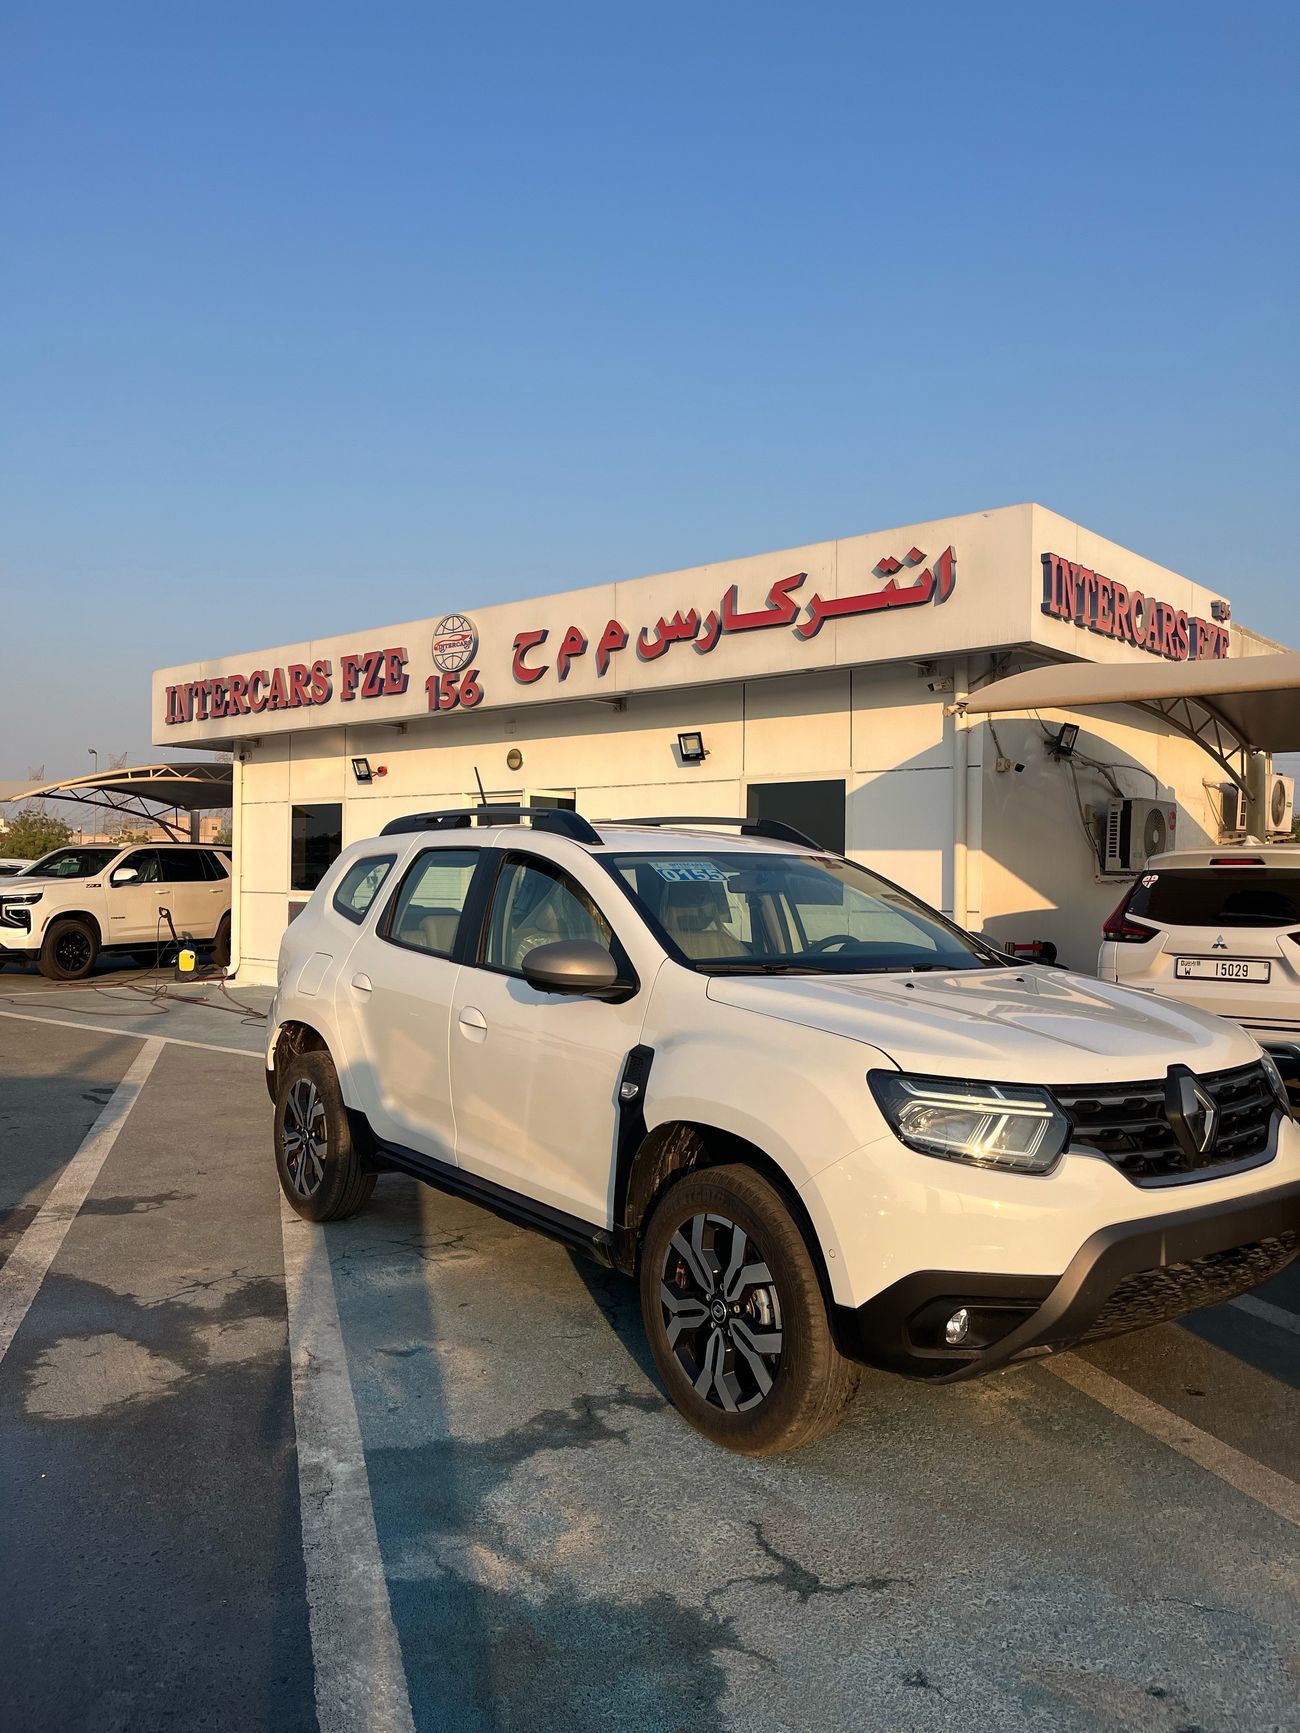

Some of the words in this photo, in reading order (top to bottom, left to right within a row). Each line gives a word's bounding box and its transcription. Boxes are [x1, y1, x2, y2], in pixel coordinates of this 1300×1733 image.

[1041, 552, 1189, 661] INTERCARS
[511, 628, 550, 684] ح
[556, 625, 588, 682] م
[594, 618, 629, 678] م
[165, 660, 333, 724] INTERCARS
[340, 646, 409, 701] FZE
[426, 670, 484, 710] 156
[662, 868, 724, 880] 0155
[1184, 967, 1192, 976] W
[1215, 962, 1249, 977] 15029
